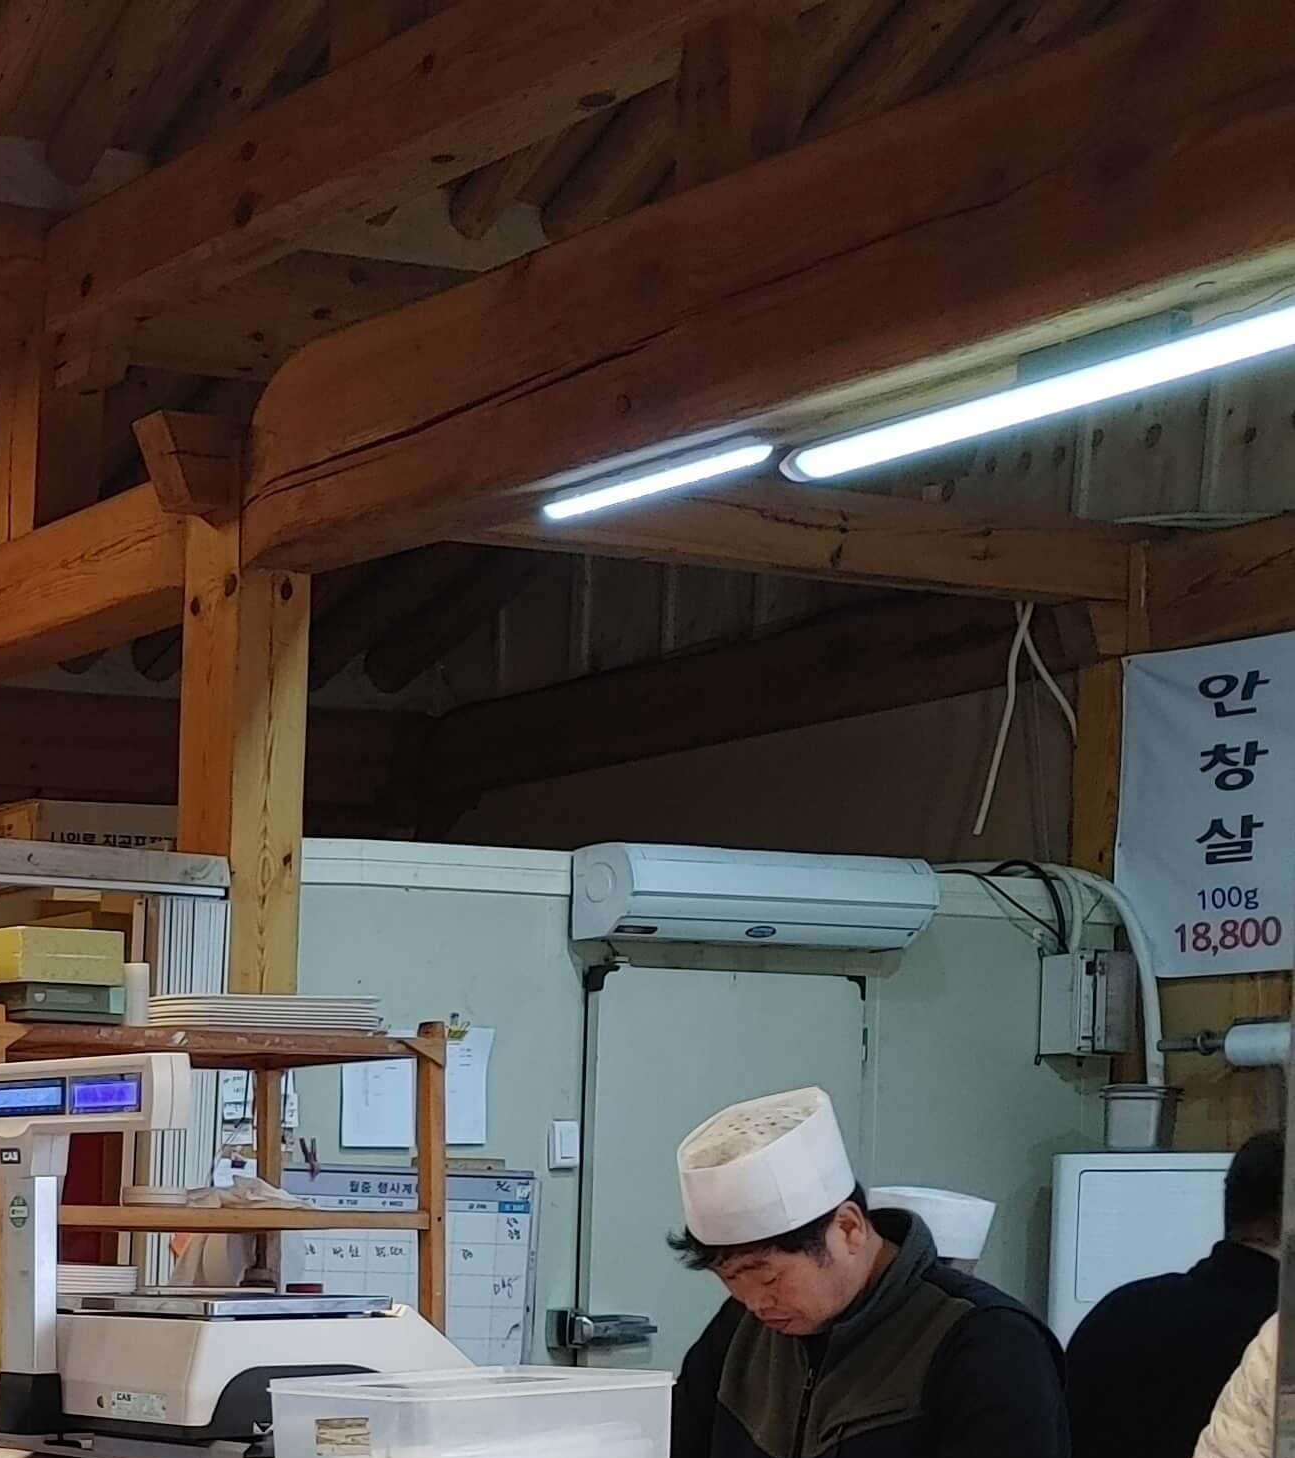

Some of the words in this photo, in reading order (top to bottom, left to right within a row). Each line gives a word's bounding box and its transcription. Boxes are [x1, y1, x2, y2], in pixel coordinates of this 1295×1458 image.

[1196, 669, 1271, 866] 안창살
[1196, 884, 1259, 912] 100g
[1173, 916, 1282, 956] 18,800
[377, 1180, 419, 1195] 행사계
[116, 1392, 132, 1402] CAS
